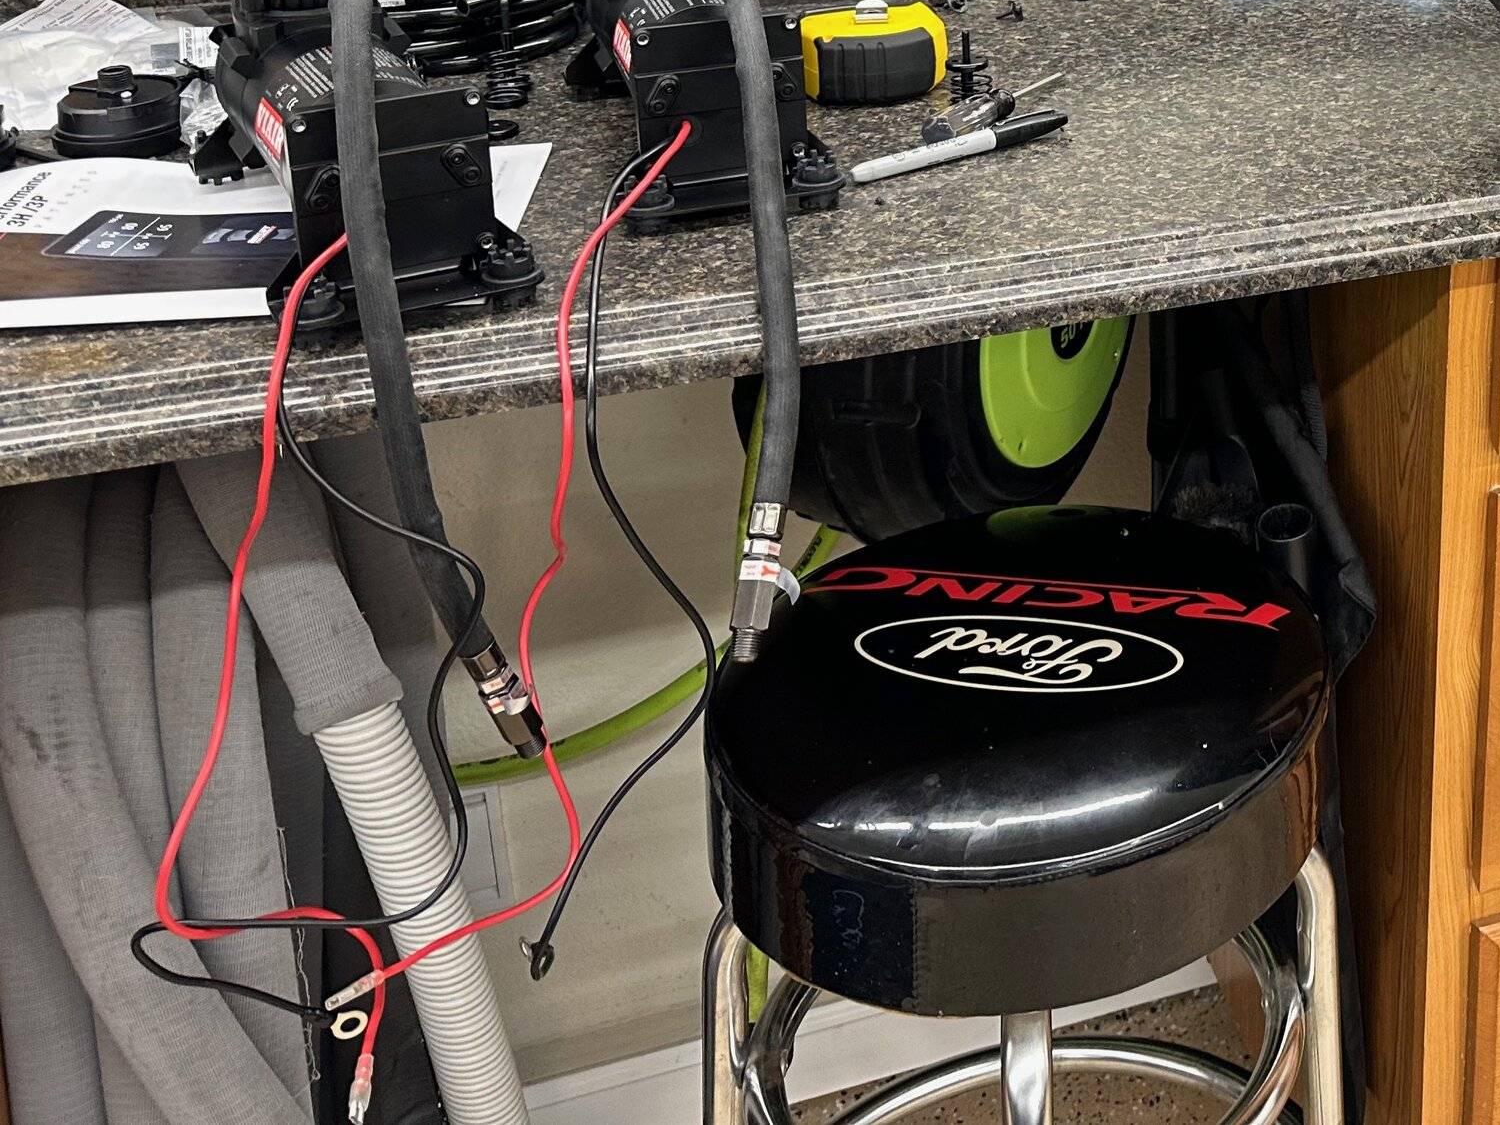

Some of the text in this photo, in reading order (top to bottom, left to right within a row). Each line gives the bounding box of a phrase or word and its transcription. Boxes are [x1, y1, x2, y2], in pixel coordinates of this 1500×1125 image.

[254, 101, 285, 159] VIAIR
[7, 210, 27, 228] 3H
[802, 567, 1290, 631] RACING
[914, 626, 1123, 684] Ford
